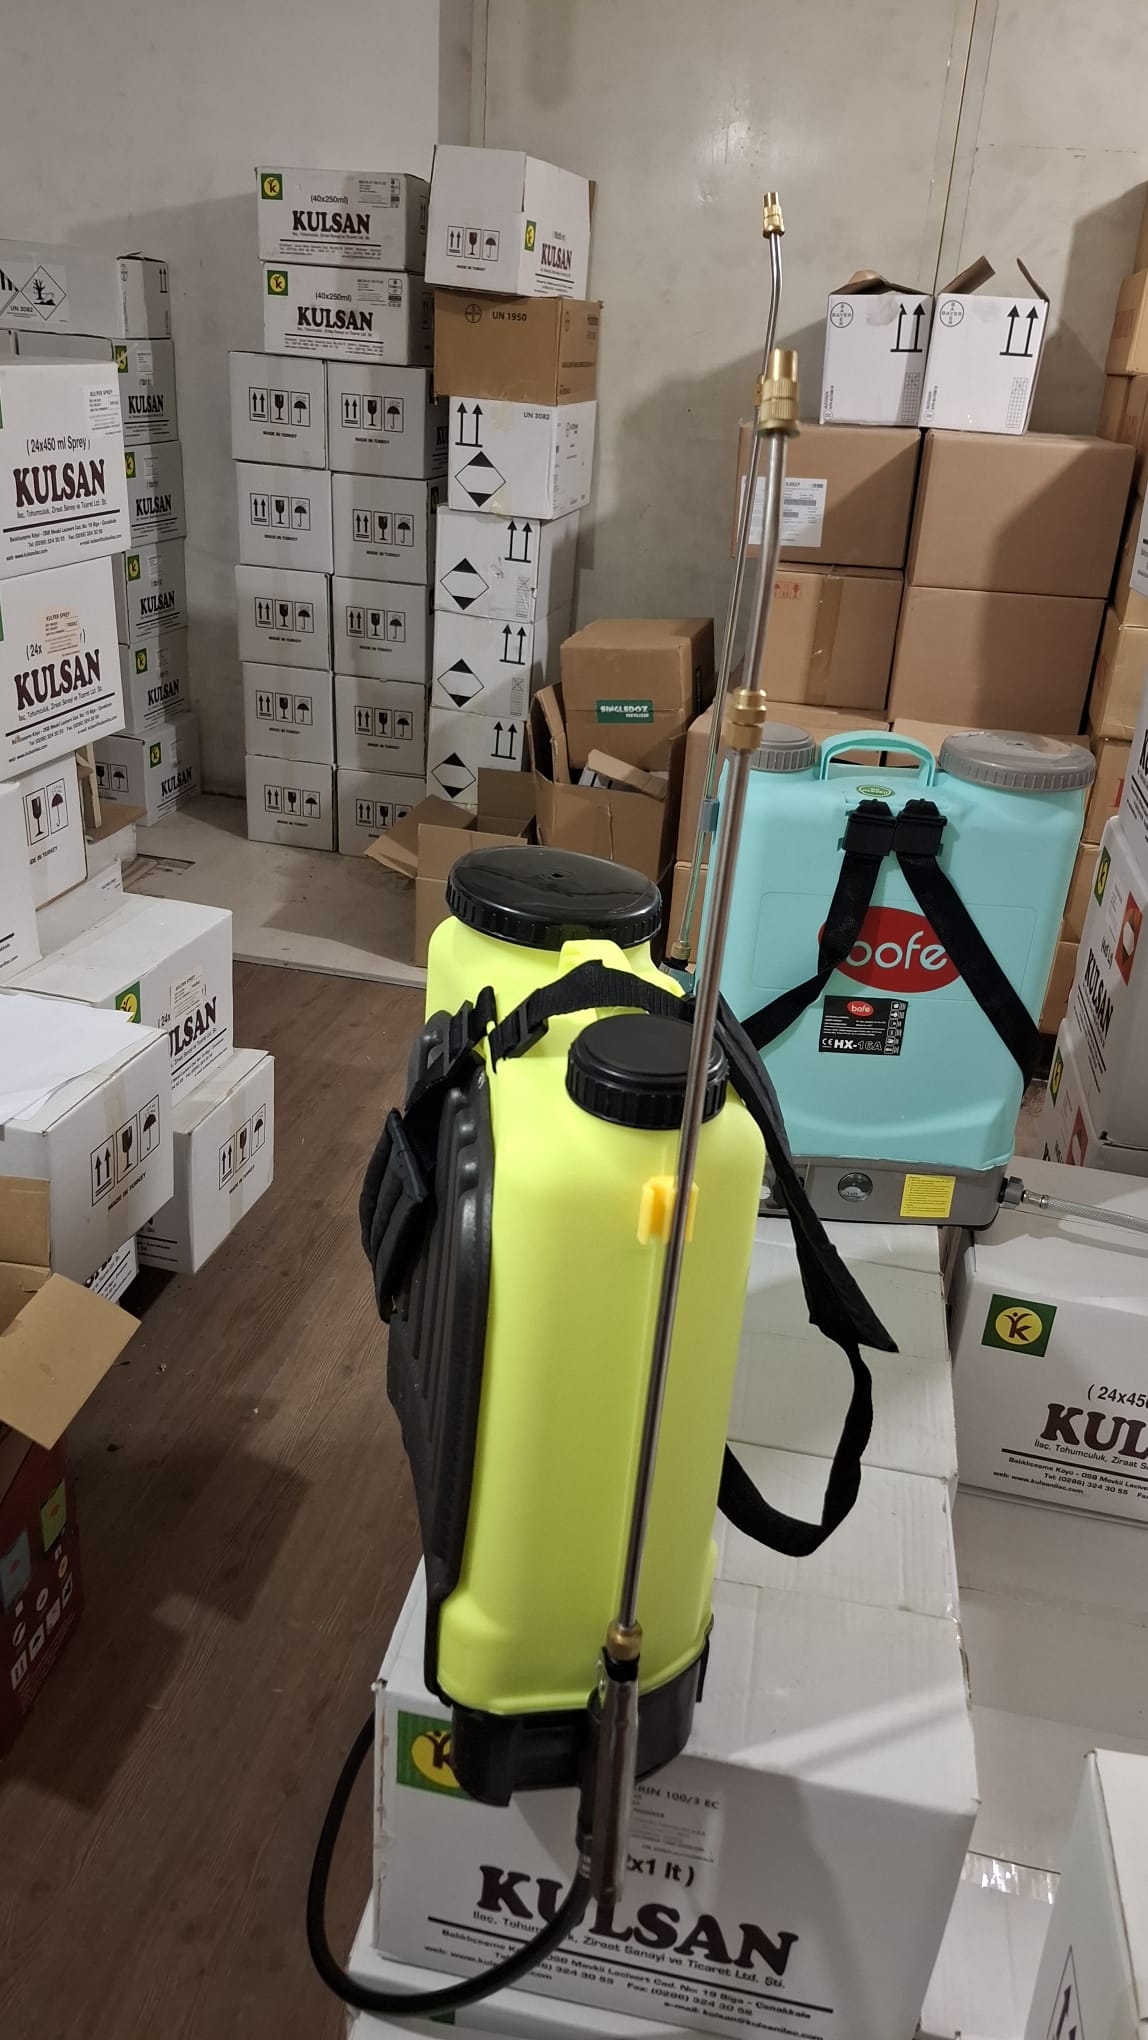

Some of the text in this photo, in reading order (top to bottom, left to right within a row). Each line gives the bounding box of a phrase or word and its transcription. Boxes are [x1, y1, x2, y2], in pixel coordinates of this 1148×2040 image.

[310, 194, 349, 205] (40x250ml)
[292, 210, 371, 236] KULSAN
[540, 243, 573, 272] KULSAN
[315, 291, 352, 302] (40x250ml)
[297, 306, 373, 332] KULSAN
[492, 311, 528, 322] UN 1950
[128, 395, 164, 414] KULSAN
[31, 438, 56, 453] 24x450
[68, 435, 87, 450] Sprey
[13, 458, 105, 508] KULSAN
[136, 494, 172, 516] KULSAN
[140, 591, 175, 616] KULSAN
[14, 649, 101, 711] KULSAN
[148, 679, 180, 706] KULSAN
[600, 705, 648, 713] SINGLEDOZ
[161, 766, 193, 797] KULSAN
[1084, 948, 1114, 1040] KULSAN
[852, 1004, 870, 1012] bofe
[169, 996, 217, 1058] LSAN
[1055, 1444, 1108, 1463] Tohumculuk,
[1111, 1456, 1138, 1468] Ziraat
[1087, 1482, 1103, 1490] 324
[1105, 1485, 1116, 1493] 30
[704, 1799, 720, 1810] EC
[476, 1865, 799, 1977] KULSAN
[583, 1936, 620, 1952] Ziraat
[624, 1945, 665, 1962] Sanayi
[669, 1958, 682, 1966] ve
[687, 1959, 731, 1977] Ticaret
[735, 1970, 759, 1983] Ltd.
[555, 1966, 578, 1977] 324
[693, 1997, 715, 2008] 324
[608, 1967, 650, 1982] Lacivert
